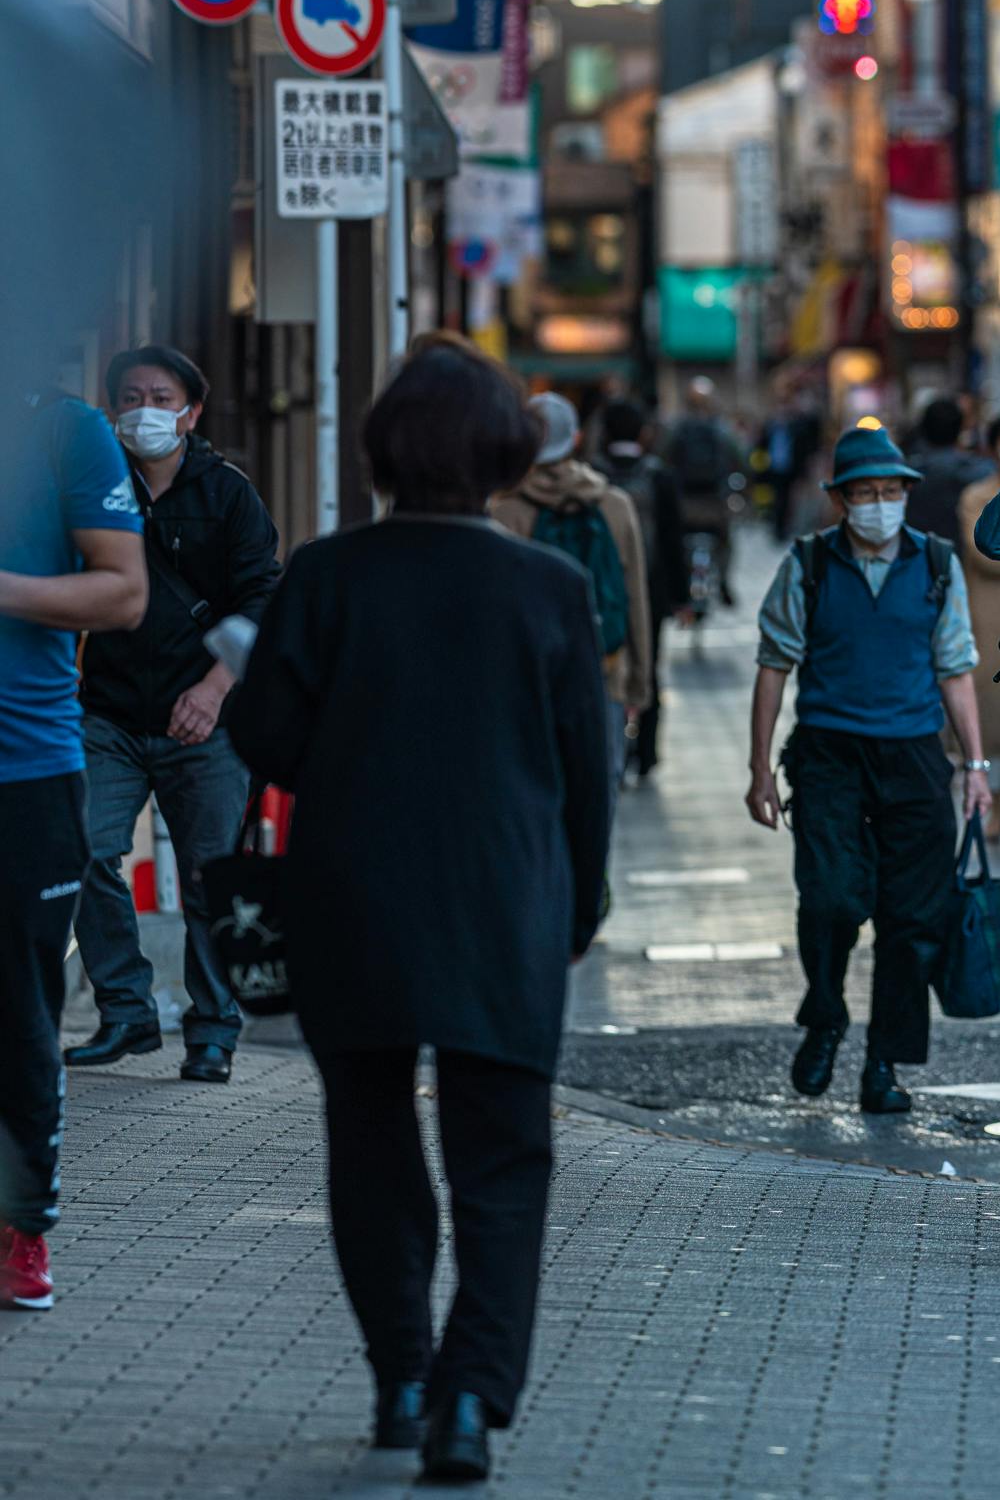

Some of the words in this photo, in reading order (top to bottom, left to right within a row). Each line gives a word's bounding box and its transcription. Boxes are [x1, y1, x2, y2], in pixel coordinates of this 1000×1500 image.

[282, 88, 382, 117] 最大積載量
[285, 182, 338, 209] を除く
